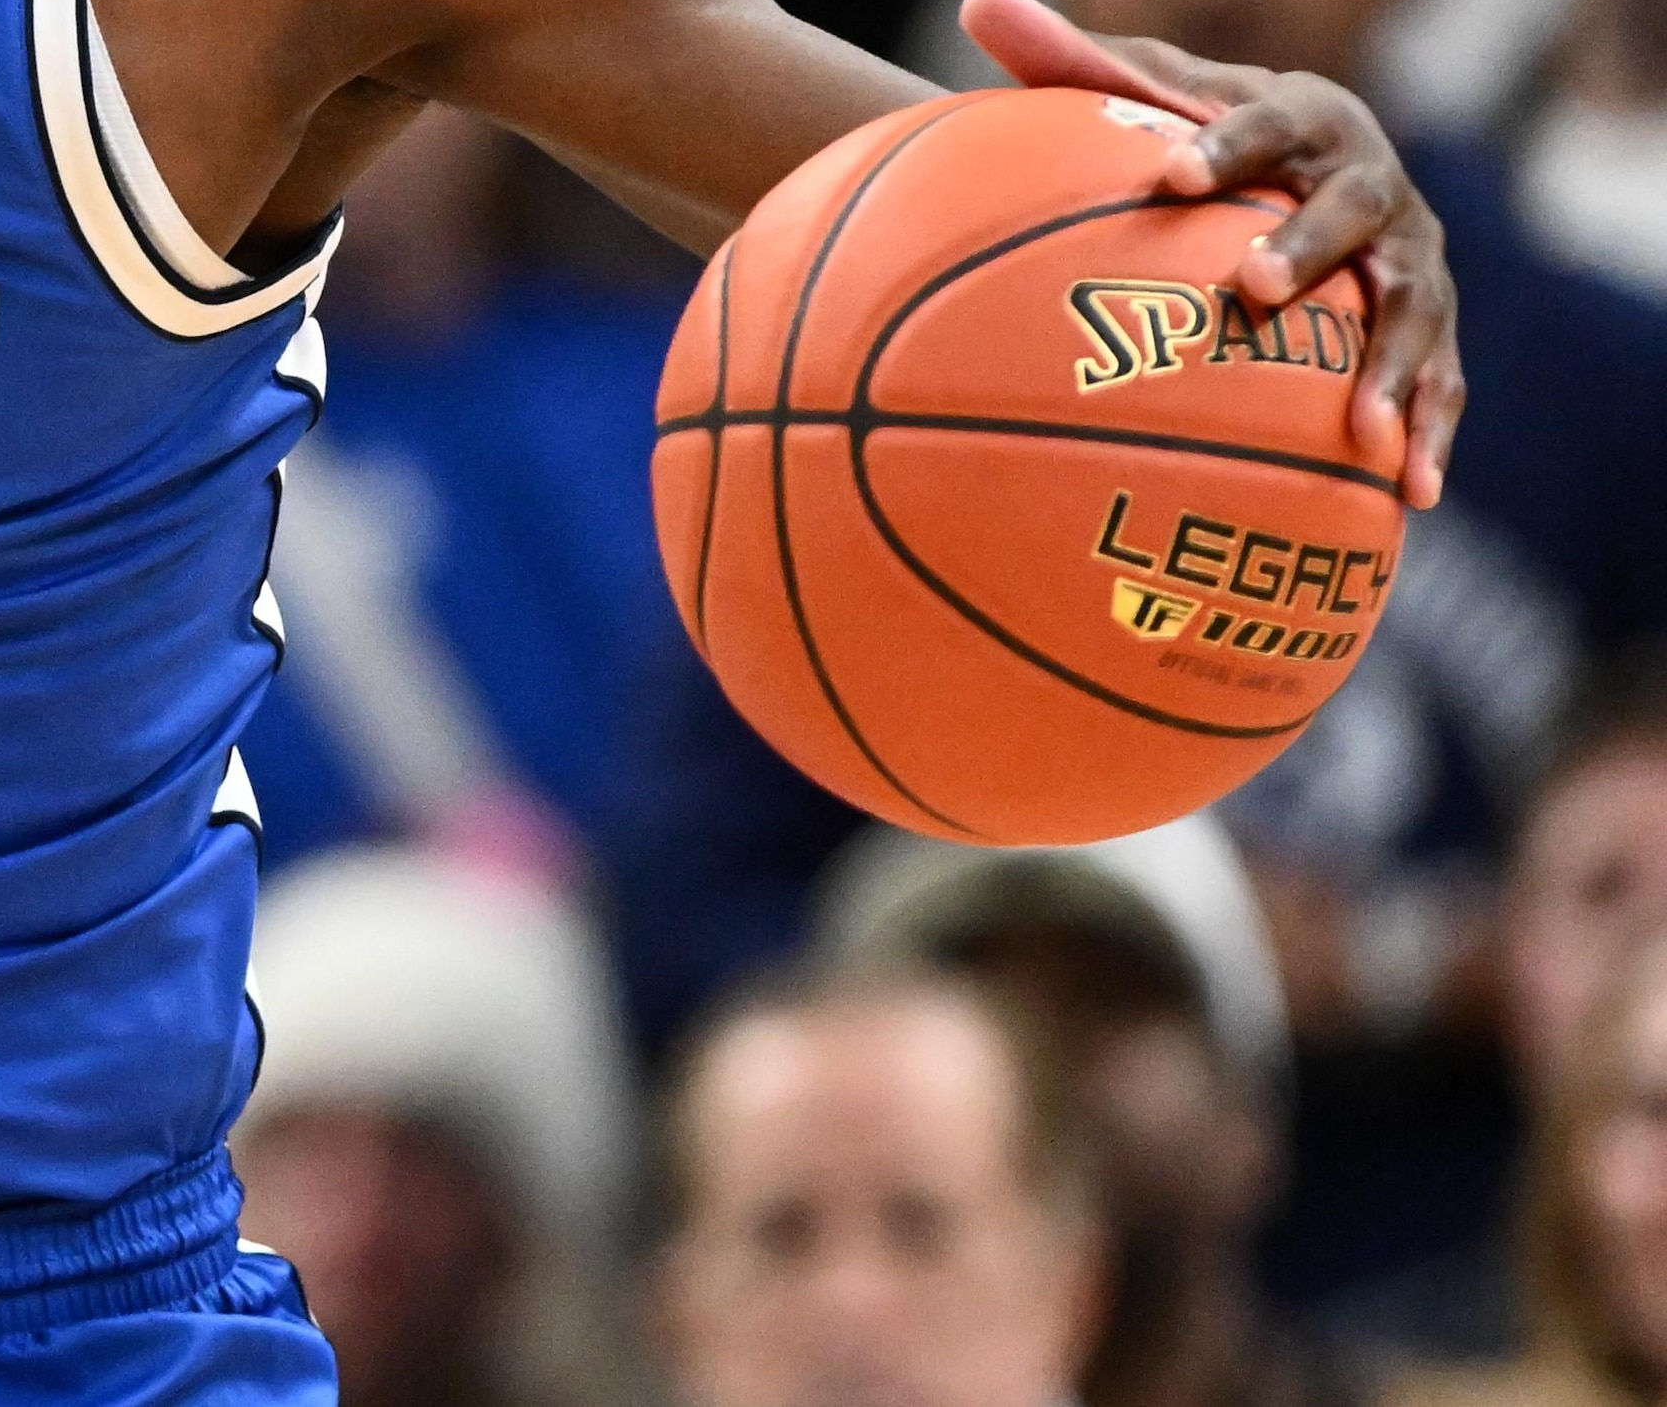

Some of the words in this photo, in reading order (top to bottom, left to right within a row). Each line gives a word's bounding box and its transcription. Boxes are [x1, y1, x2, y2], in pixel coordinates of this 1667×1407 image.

[1067, 278, 1364, 395] SPALD
[1092, 491, 1392, 614] LEGACY
[1198, 610, 1358, 662] 1000
